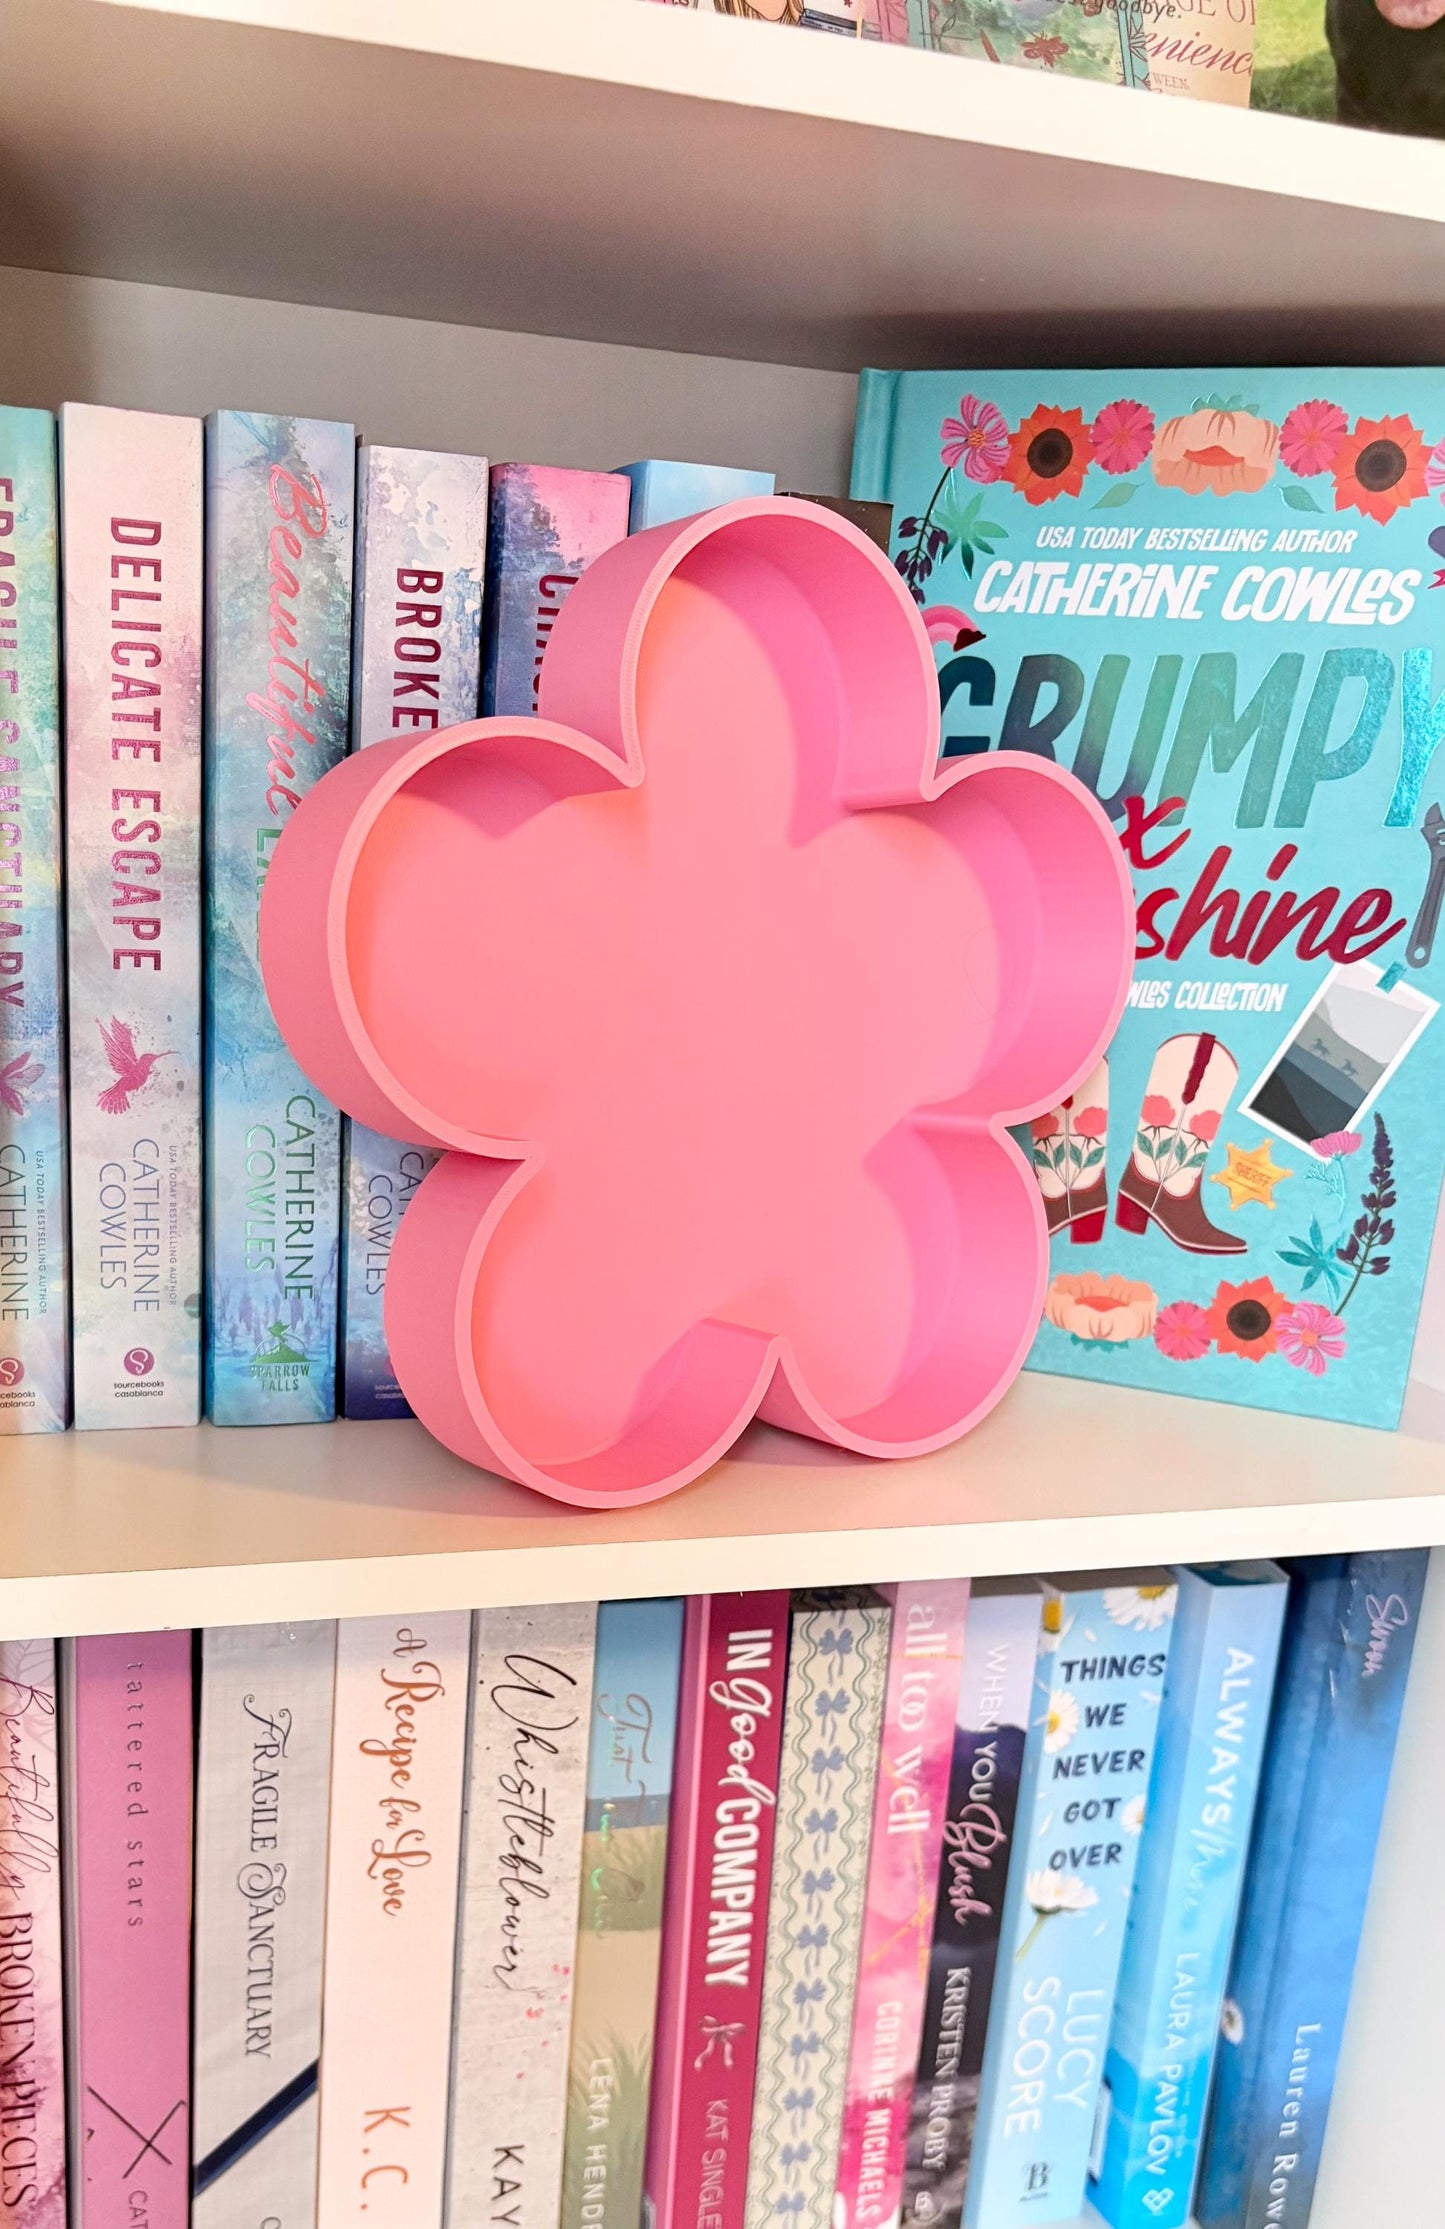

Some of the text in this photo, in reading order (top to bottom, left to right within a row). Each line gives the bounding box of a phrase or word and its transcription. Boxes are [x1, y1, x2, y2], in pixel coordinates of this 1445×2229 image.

[1035, 525, 1074, 548] USA
[1079, 526, 1144, 549] TODAY
[1270, 529, 1358, 553] AUTHOR
[245, 462, 328, 816] Beautiful
[391, 567, 444, 730] BROKE
[110, 515, 162, 972] DELICATE ESCAPE
[936, 647, 1445, 829] GRUMPY
[1134, 843, 1408, 965] shine
[169, 1145, 177, 1164] USA
[169, 1167, 177, 1199] TODAY
[244, 1124, 277, 1273] COWLES
[284, 1095, 316, 1301] CATHERINE
[0, 1144, 29, 1321] CATHERINE
[35, 1150, 47, 1315] USA TODAY BESTSELLING AUTHOR
[99, 1163, 127, 1289] COWLES
[133, 1139, 160, 1312] CATHERINE
[169, 1202, 177, 1264] BESTSELLING
[366, 1174, 393, 1296] COWLES
[0, 1390, 36, 1399] cebooks
[0, 1400, 35, 1408] ablanca
[113, 1381, 164, 1389] sourcebooks
[114, 1390, 164, 1398] casablanca
[249, 1363, 310, 1378] SPARROW
[262, 1379, 299, 1392] FALLS
[726, 1629, 773, 1672] IN
[1060, 1653, 1166, 1684] THINGS
[359, 1661, 446, 1789] Recipe
[887, 1604, 948, 1835] all too well
[1052, 1748, 1145, 1780] NEVER
[1084, 1702, 1127, 1728] WE
[1201, 1646, 1256, 1827] ALWAYS
[127, 1662, 149, 1927] tattered stars
[379, 1797, 422, 1829] for
[491, 1654, 579, 1990] Whistleblower
[942, 1642, 1010, 1927] WHEN YOU Blush
[1063, 1797, 1122, 1824] GOT
[237, 1693, 292, 2059] FRAGILE SANCTUARY
[367, 1829, 432, 1917] Love
[704, 1798, 761, 1988] COMPANY
[1048, 1842, 1123, 1872] OVER
[0, 1912, 36, 2067] BROKEN
[935, 1966, 972, 2083] KRISTEN
[1053, 1989, 1106, 2110] LUCY
[1165, 1952, 1200, 2053] LAURA
[586, 2057, 614, 2135] LENA
[855, 2001, 903, 2224] CORINNE MICHAELS
[1003, 1975, 1063, 2140] SCORE
[1278, 2023, 1322, 2140] Lauren
[1, 2079, 39, 2208] PIECES
[697, 2099, 729, 2229] KAT SINGLE
[922, 2083, 955, 2172] PROBY
[1146, 2063, 1184, 2176] PAVLOV
[490, 2144, 525, 2226] KAY
